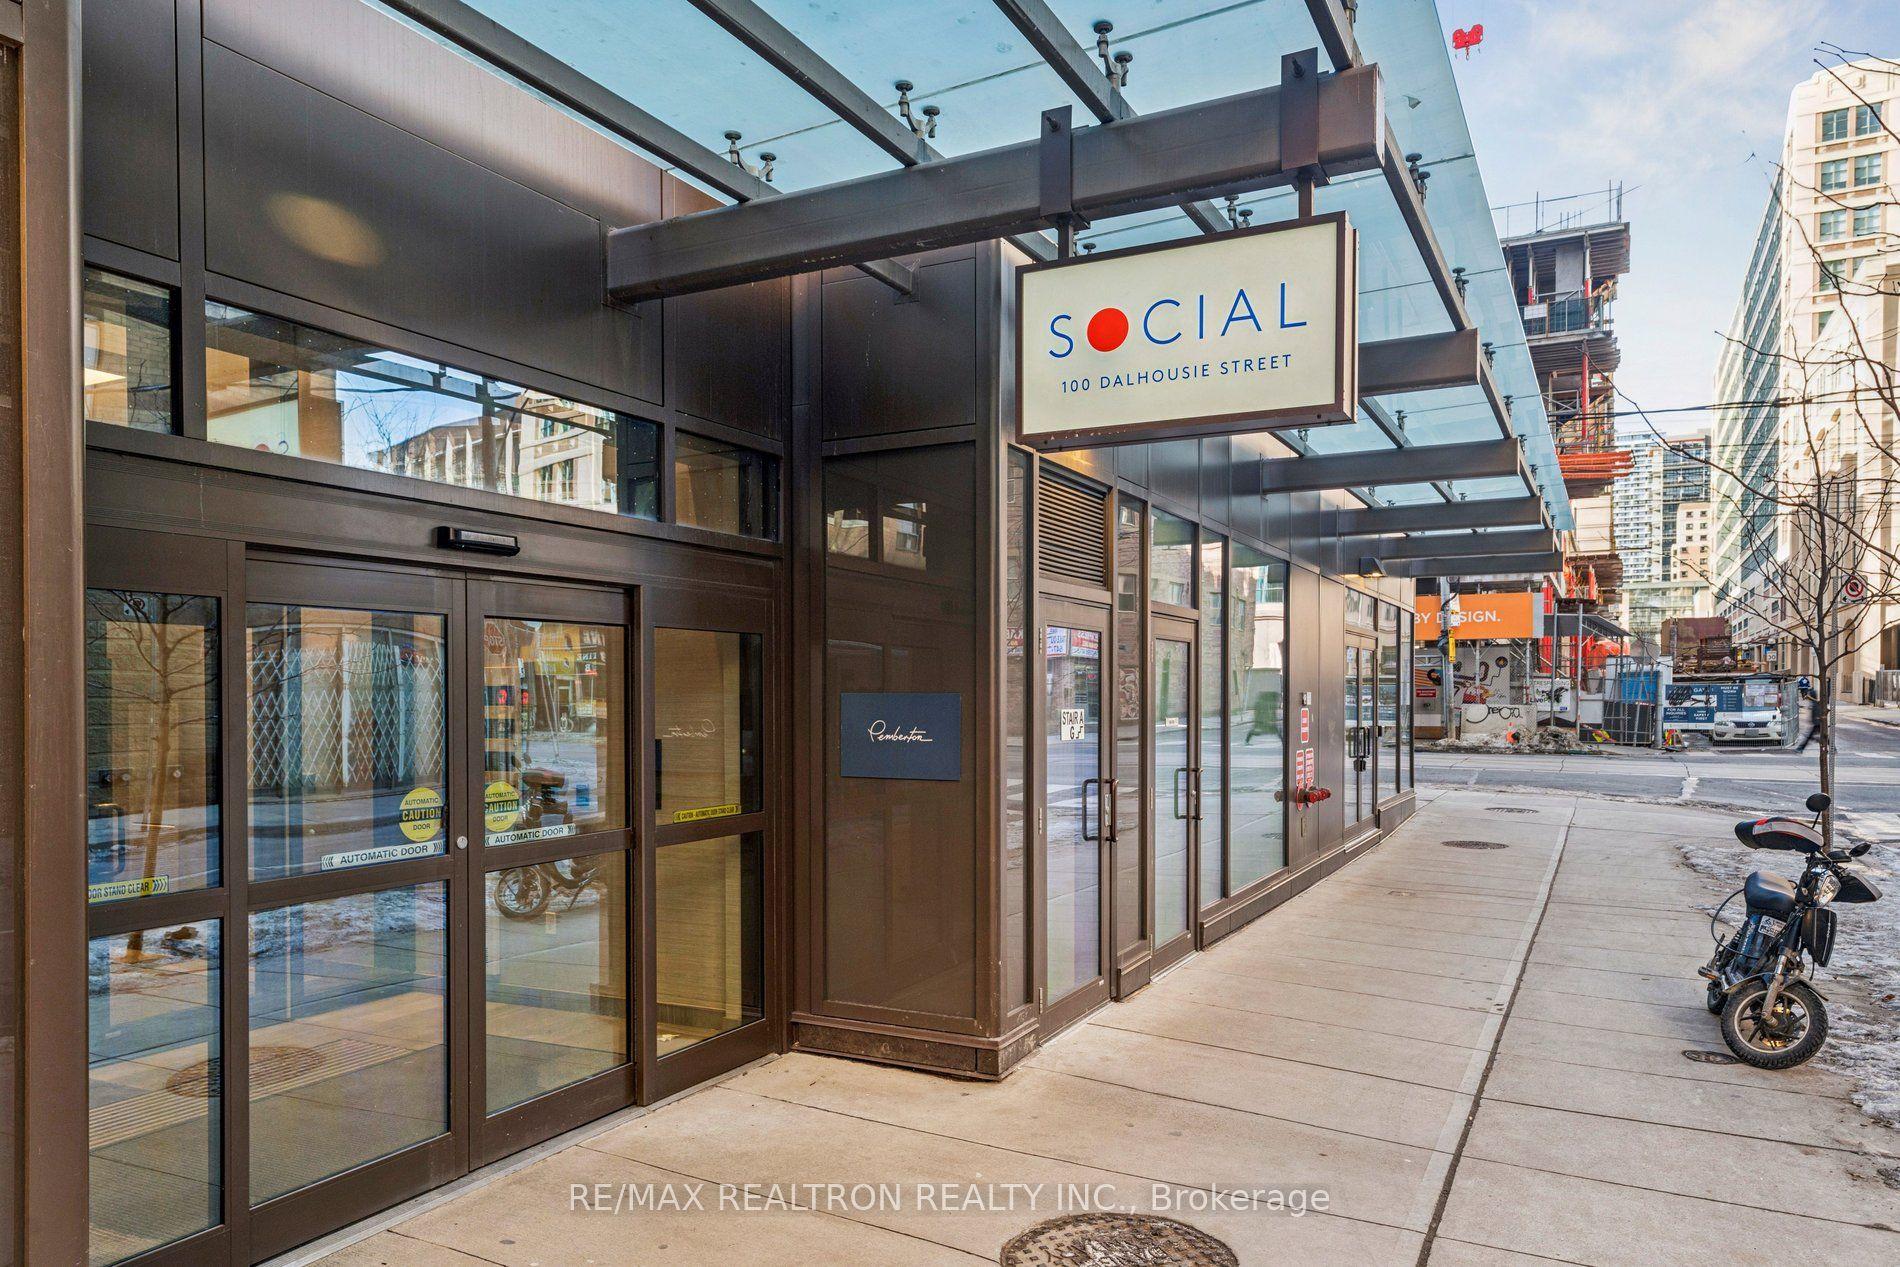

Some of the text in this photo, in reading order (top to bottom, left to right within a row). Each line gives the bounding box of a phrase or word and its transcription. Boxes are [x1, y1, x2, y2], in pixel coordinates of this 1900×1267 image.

[1048, 282, 1307, 359] SOCIAL
[1062, 353, 1292, 394] 100 DALHOUSIE STREET
[1436, 610, 1502, 624] DSIGN.
[1062, 711, 1083, 725] STAIR A
[867, 719, 933, 743] Pemberton
[1069, 726, 1074, 740] G
[404, 797, 439, 806] AUTOMATIC
[485, 791, 515, 799] AUTOMATIC
[402, 807, 441, 821] CAUTION
[485, 801, 518, 813] CAUTION
[413, 823, 431, 831] DOOR
[495, 826, 564, 844] AUTOMATIC DOOR
[340, 844, 429, 864] AUTOMATIC DOOR
[88, 882, 149, 899] OOR STAND CLEAR
